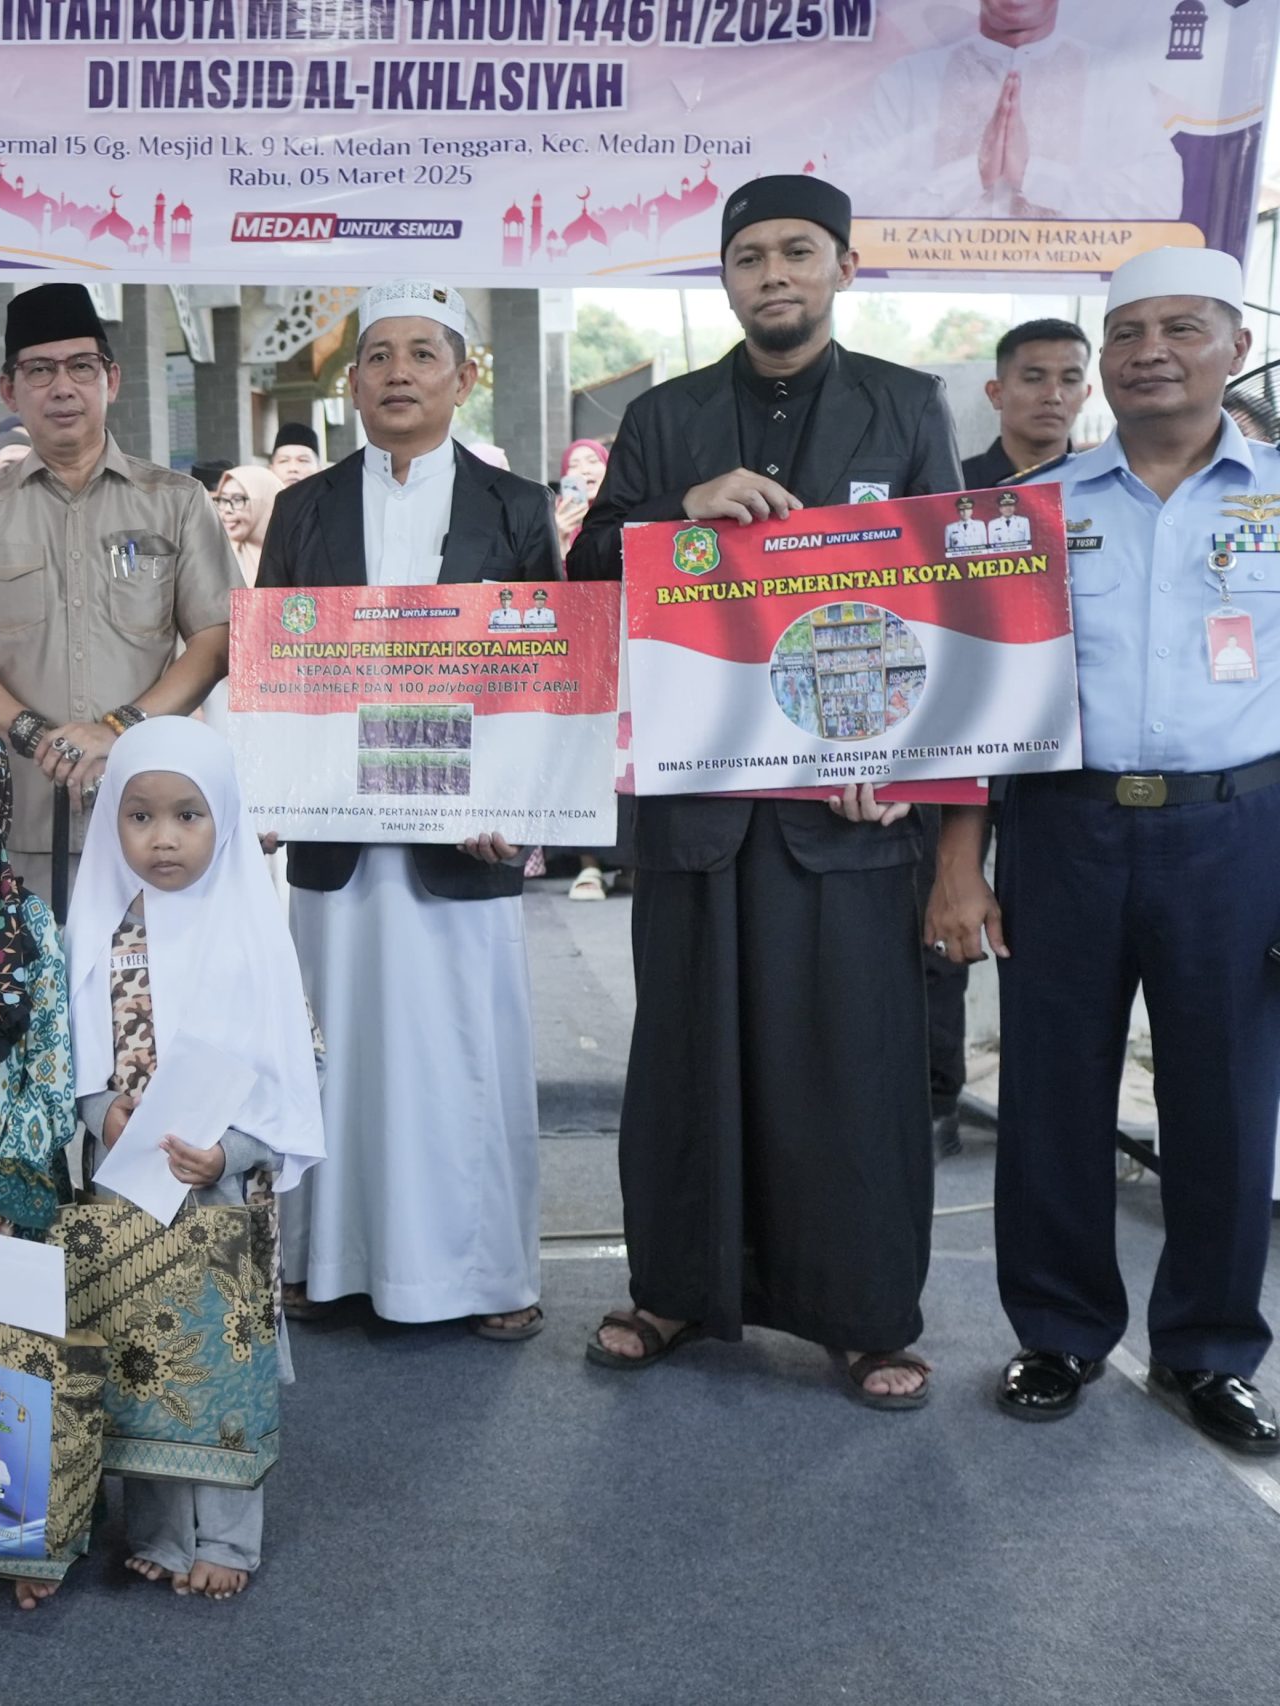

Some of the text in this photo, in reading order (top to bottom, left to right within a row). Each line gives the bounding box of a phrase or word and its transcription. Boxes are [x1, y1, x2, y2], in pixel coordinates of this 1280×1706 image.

[132, 0, 235, 40] KOTA
[246, 0, 395, 40] MEDAN
[407, 0, 544, 41] TAHUN
[557, 0, 654, 42] 1446
[664, 0, 823, 44] H/2025
[834, 0, 872, 37] M
[88, 60, 623, 111] DI MASJID AL-IKHLASIYAH
[65, 134, 86, 156] 15
[93, 134, 130, 160] Gg.
[138, 134, 213, 160] Mesjid
[221, 134, 252, 156] Lk.
[261, 135, 274, 156] 9
[283, 135, 324, 157] Kel.
[333, 135, 411, 157] Medan
[418, 135, 533, 159] Tenggara,
[541, 133, 589, 154] Kec.
[598, 133, 676, 155] Medan
[684, 133, 751, 155] Denai
[228, 164, 473, 188] Rabu, 05 Maret 2025
[234, 216, 455, 239] MEDAN UNTUK SEMUA
[882, 227, 1133, 245] H. ZAKIYUDDIN HARAHAP
[907, 248, 1102, 263] WAKIL WALI KOTA MEDAN
[763, 529, 898, 553] MEDAN UNTUK SEMUA
[1076, 538, 1098, 548] YUSRI
[656, 554, 1049, 605] BANTUAN PEMERINTAH KOTA MEDAN
[353, 608, 458, 620] MEDAN UNTUK SEMUA
[271, 639, 568, 658] BANTUAN PEMERINTAH KOTA MEDAN
[297, 662, 540, 677] KEPADA KELOMPOK MASYARAKAT
[260, 680, 580, 695] BUDIKDAMBER DAN 100 polybag BIBIT CABAI
[658, 740, 1060, 772] DINAS PERPUSTAKAAN DAN KEARSIPAN PEMERINTAH KOTA MEDAN
[817, 765, 891, 778] TAHUN 2025
[268, 805, 329, 816] KETAHANAN
[379, 807, 438, 818] PERTANIAN
[439, 807, 461, 818] DAN
[464, 807, 525, 819] PERIKANAN
[527, 808, 556, 819] KOTA
[558, 808, 597, 819] MEDAN
[380, 821, 445, 832] TAHUN 2025
